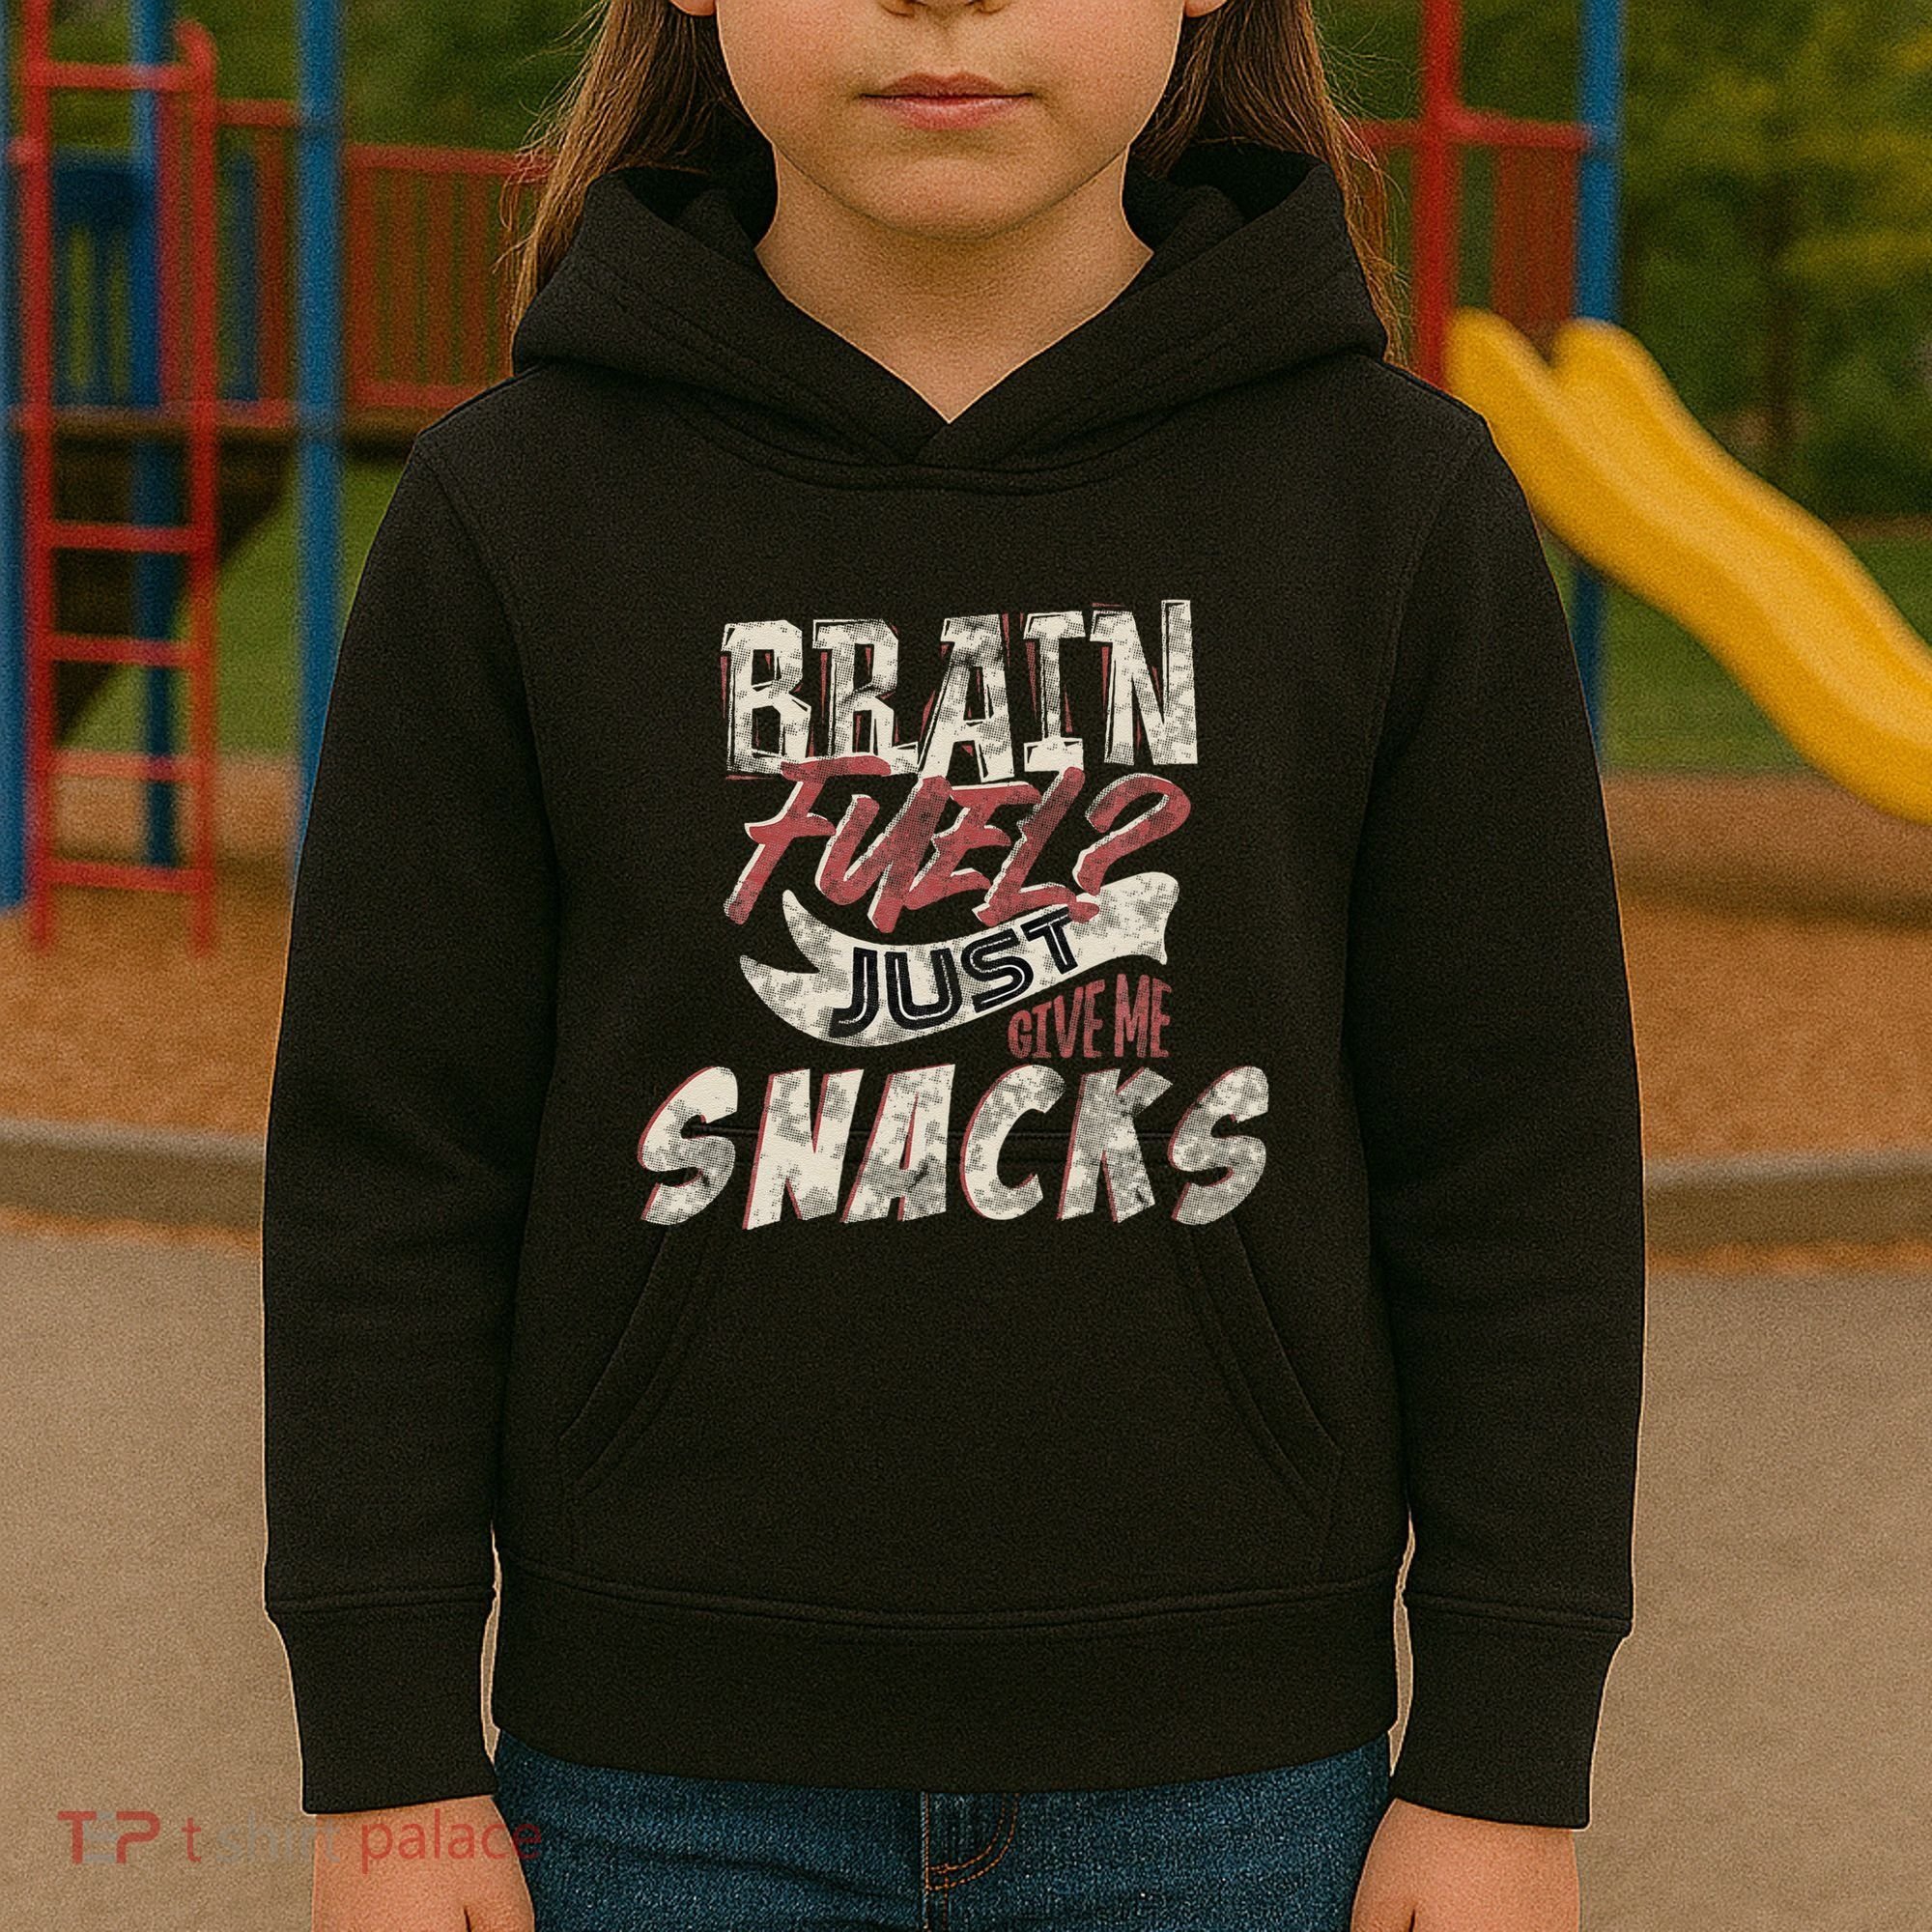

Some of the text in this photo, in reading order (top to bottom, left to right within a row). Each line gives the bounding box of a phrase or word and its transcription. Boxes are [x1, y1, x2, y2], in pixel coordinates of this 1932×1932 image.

[721, 599, 1198, 781] BRAIN
[724, 767, 1191, 933] FUEL?
[829, 905, 1079, 1037] JUST
[1007, 973, 1172, 1060] GIVE ME
[638, 1064, 1269, 1230] SNACKS
